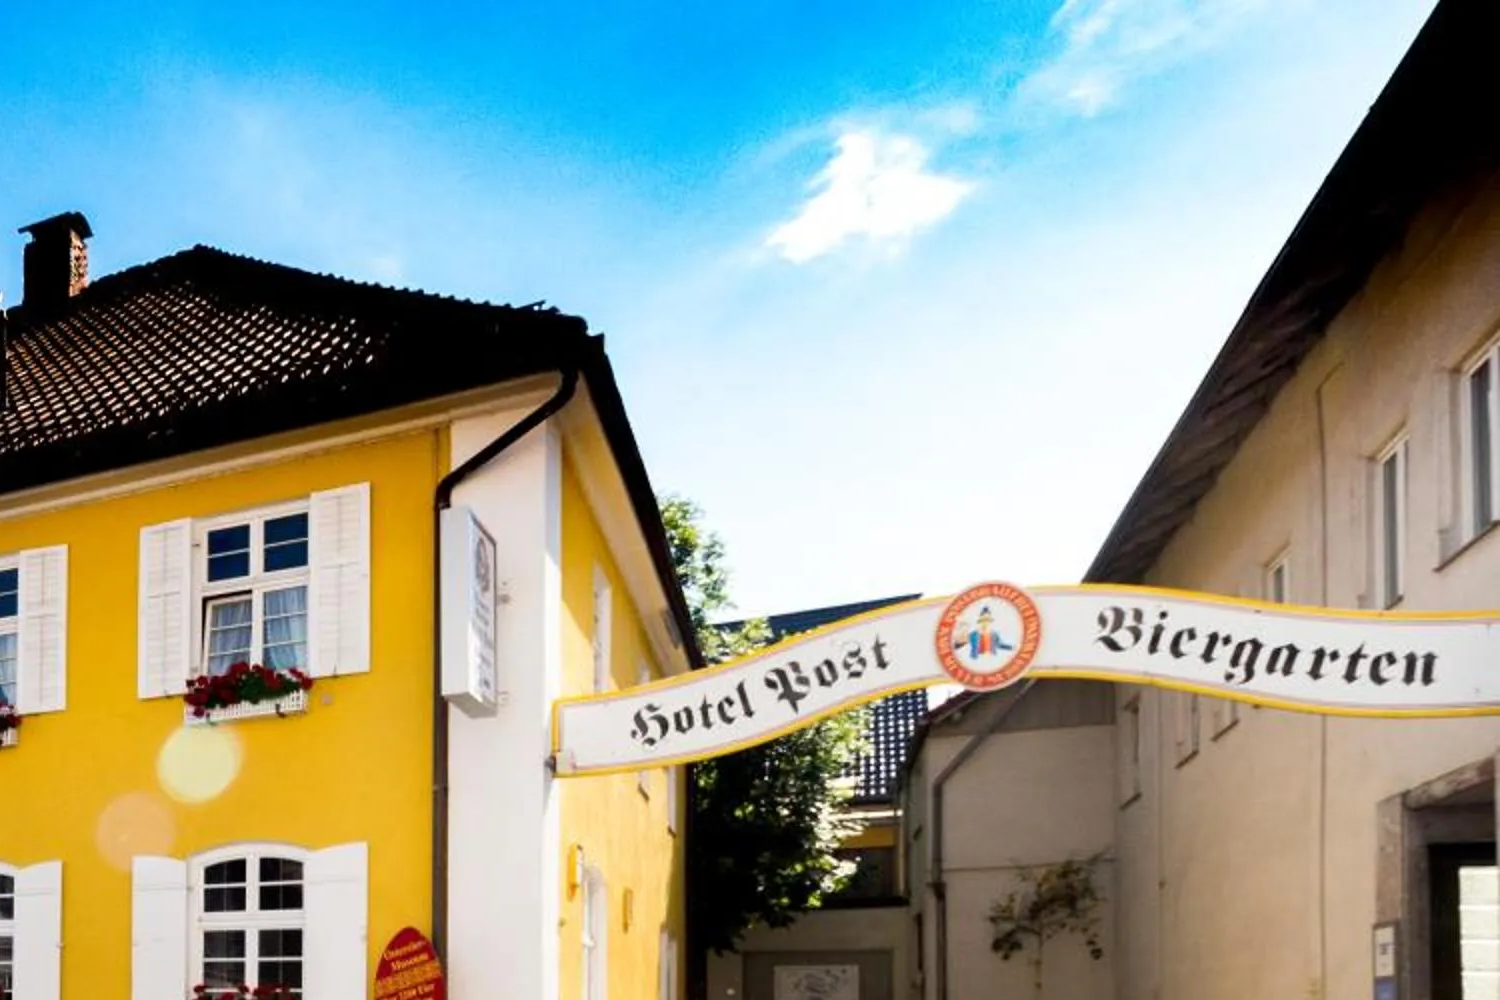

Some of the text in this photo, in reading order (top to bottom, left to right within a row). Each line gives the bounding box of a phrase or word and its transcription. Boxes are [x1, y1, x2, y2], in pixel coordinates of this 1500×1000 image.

[630, 677, 754, 747] Hotel
[764, 633, 891, 715] Post
[1093, 605, 1438, 686] Biergarten
